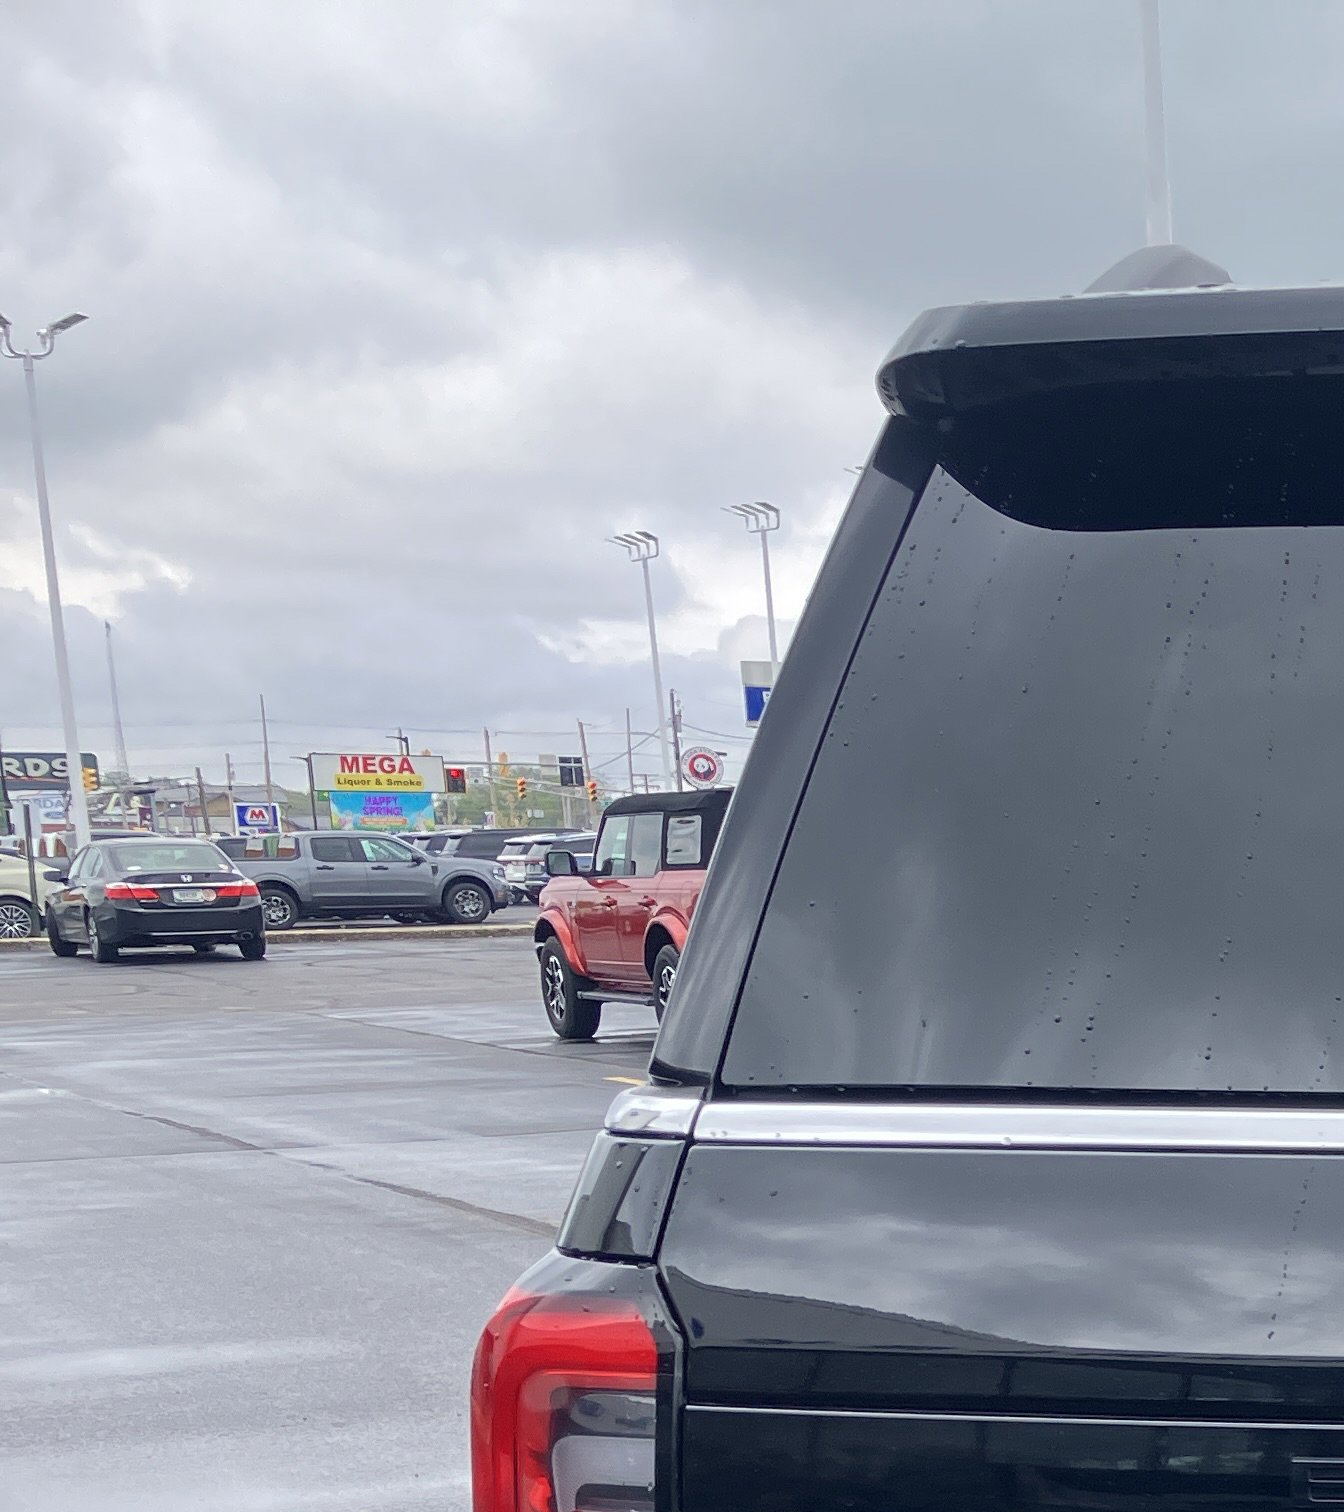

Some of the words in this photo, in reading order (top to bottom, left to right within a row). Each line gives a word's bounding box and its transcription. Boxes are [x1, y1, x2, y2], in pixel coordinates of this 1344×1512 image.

[340, 755, 415, 774] MEGA
[337, 777, 371, 786] Liquor
[386, 779, 422, 787] Smoke
[364, 796, 398, 805] HAPPY
[362, 806, 403, 816] SPRING!
